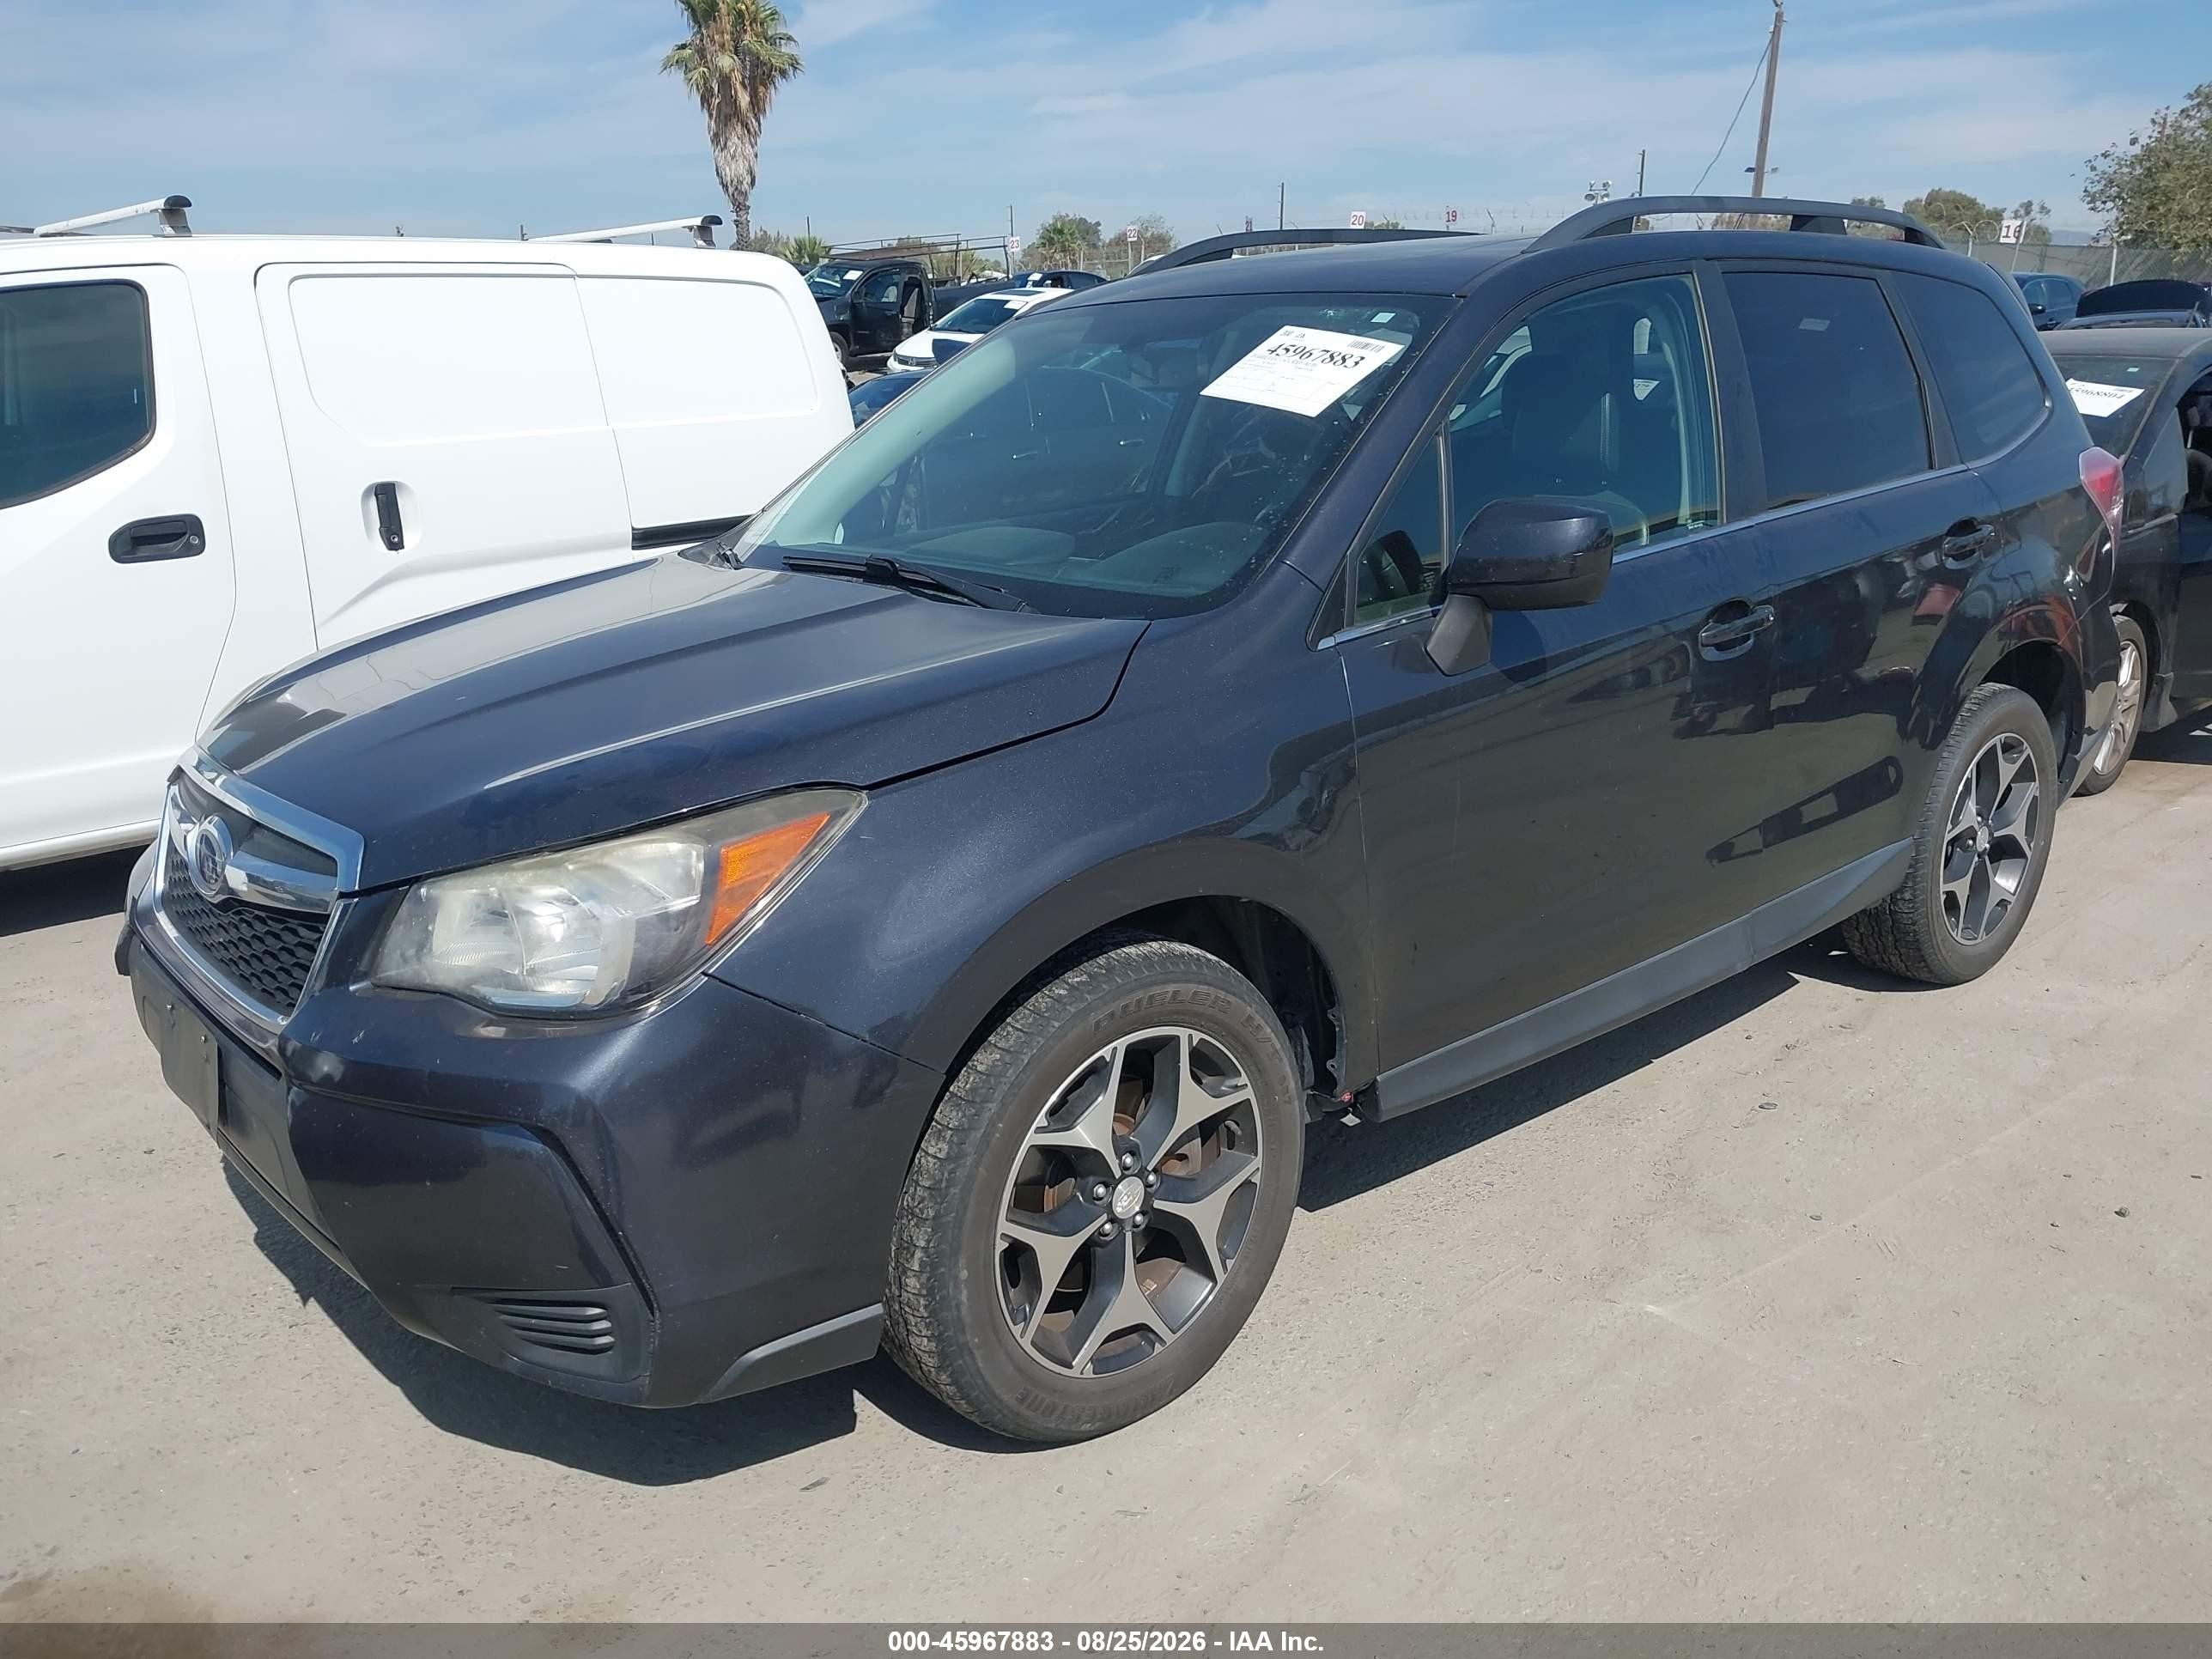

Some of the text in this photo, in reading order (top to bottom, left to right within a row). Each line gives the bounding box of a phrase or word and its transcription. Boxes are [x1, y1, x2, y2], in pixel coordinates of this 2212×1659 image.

[1350, 214, 1364, 227] 20
[1445, 210, 1457, 223] 19
[1245, 220, 1253, 232] 21
[2002, 224, 2021, 240] 16
[1127, 228, 1138, 239] 22
[1010, 240, 1020, 249] 23
[1266, 343, 1365, 369] 45967883
